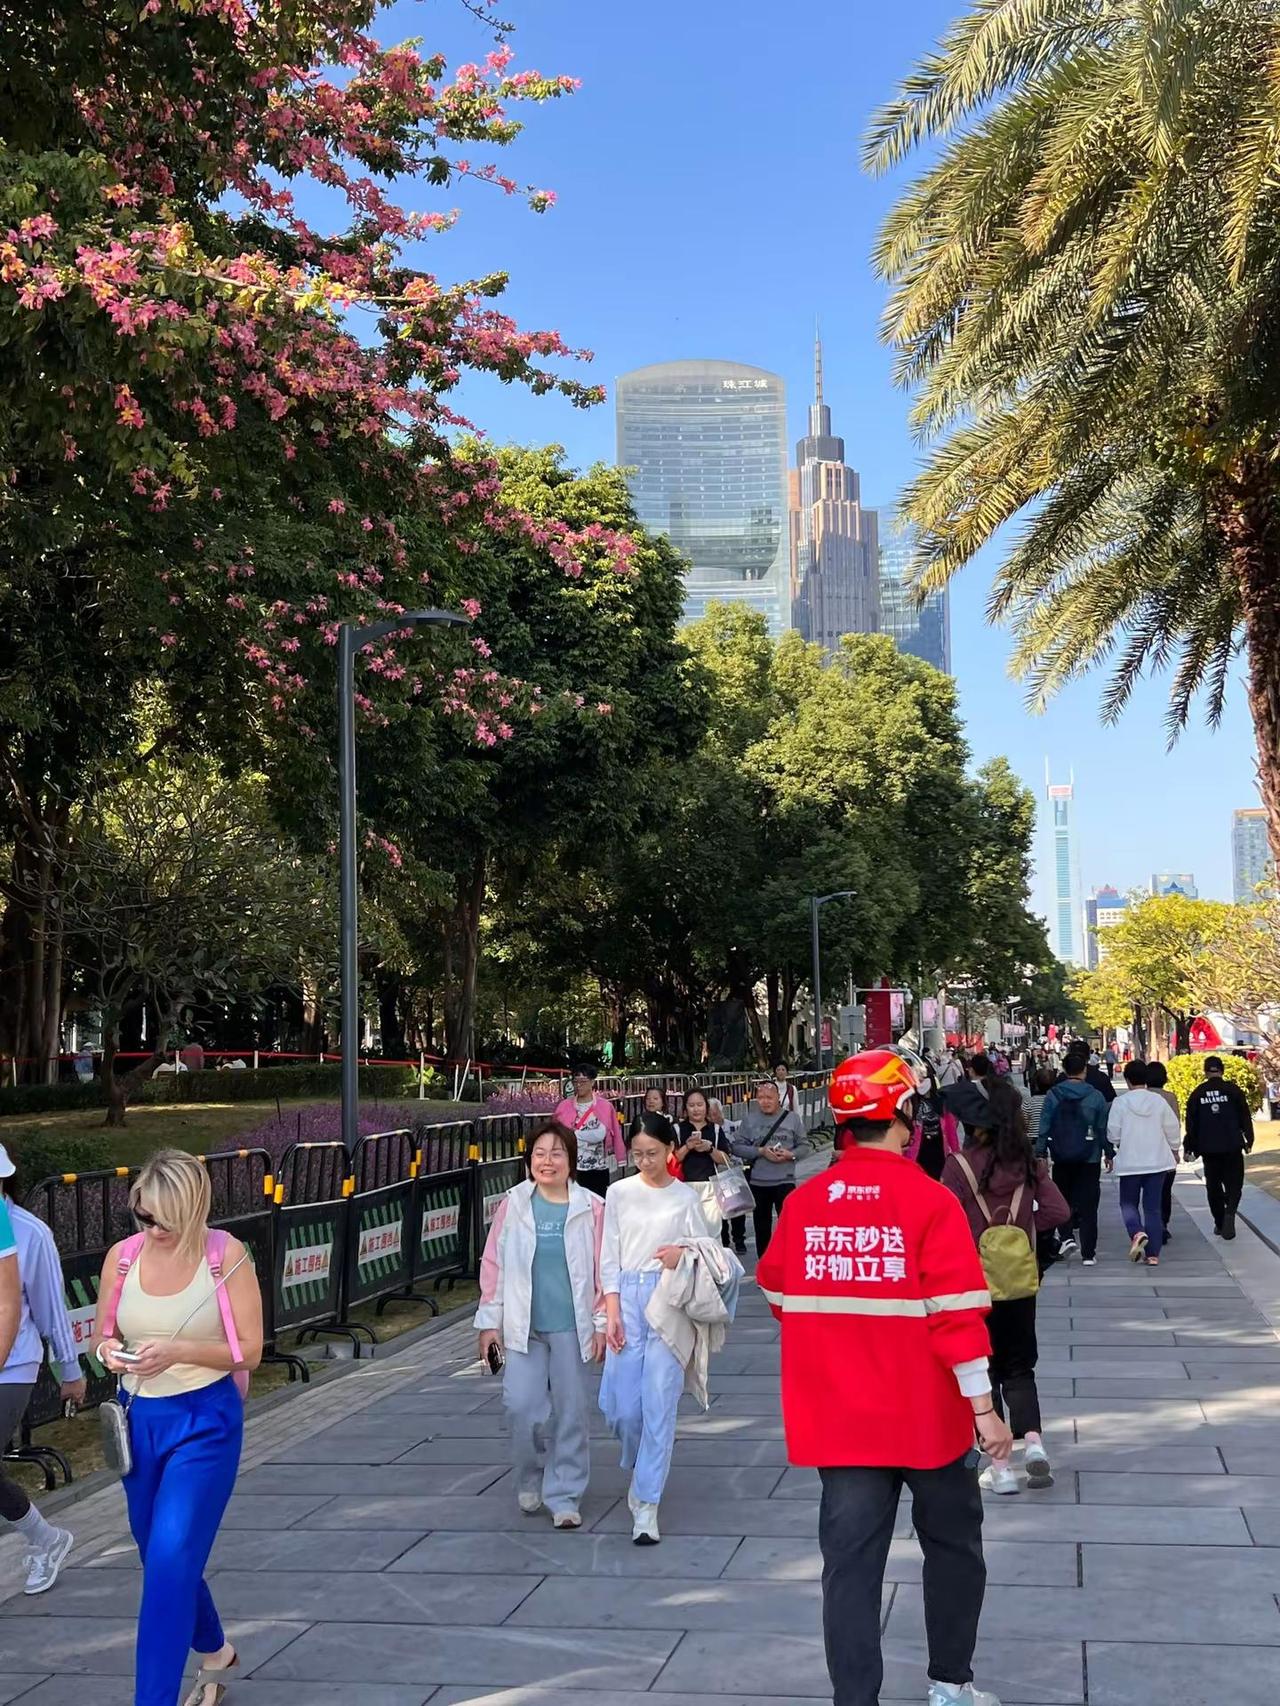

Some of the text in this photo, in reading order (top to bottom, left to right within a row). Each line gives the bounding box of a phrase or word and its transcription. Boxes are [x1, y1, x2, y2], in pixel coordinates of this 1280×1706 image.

[722, 379, 768, 390] 珠江城
[1200, 1095, 1228, 1104] BALANCE
[804, 1225, 905, 1253] 京东秒送
[804, 1254, 907, 1283] 好物立享
